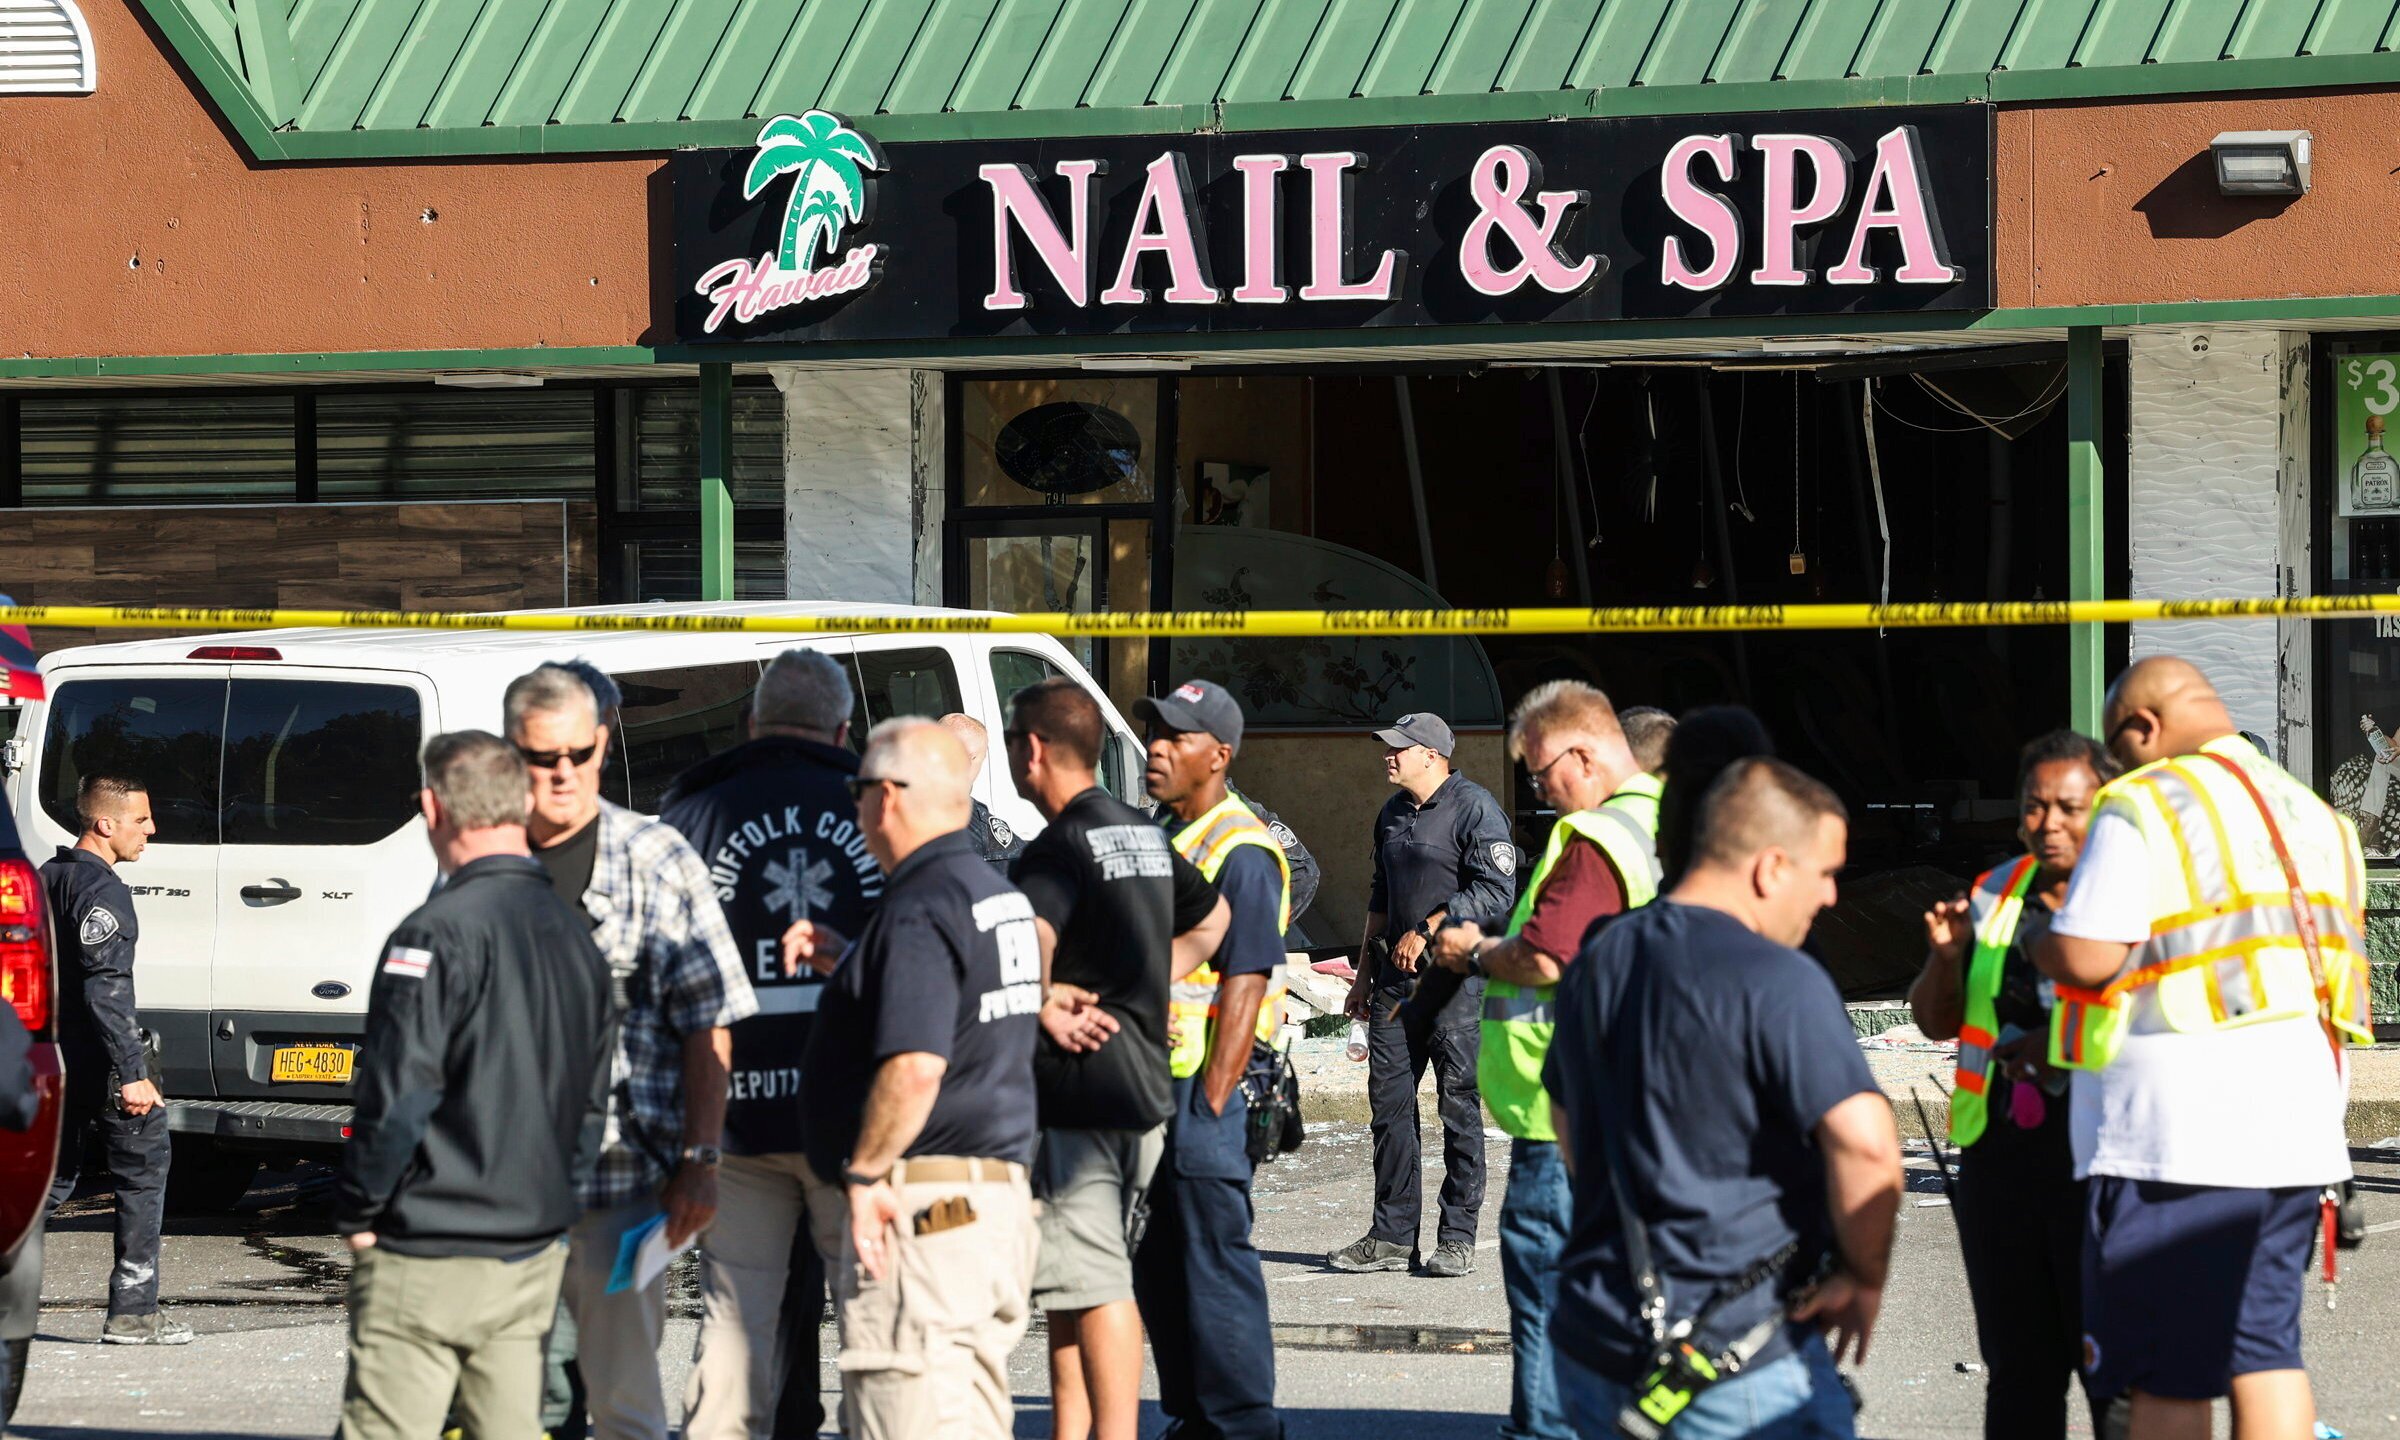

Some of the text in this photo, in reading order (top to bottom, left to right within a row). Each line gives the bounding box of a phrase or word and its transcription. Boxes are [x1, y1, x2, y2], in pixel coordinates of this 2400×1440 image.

[979, 125, 1956, 309] NAIL & SPA
[696, 244, 877, 333] Hawaii
[322, 891, 353, 899] XLT
[319, 985, 341, 995] Ford
